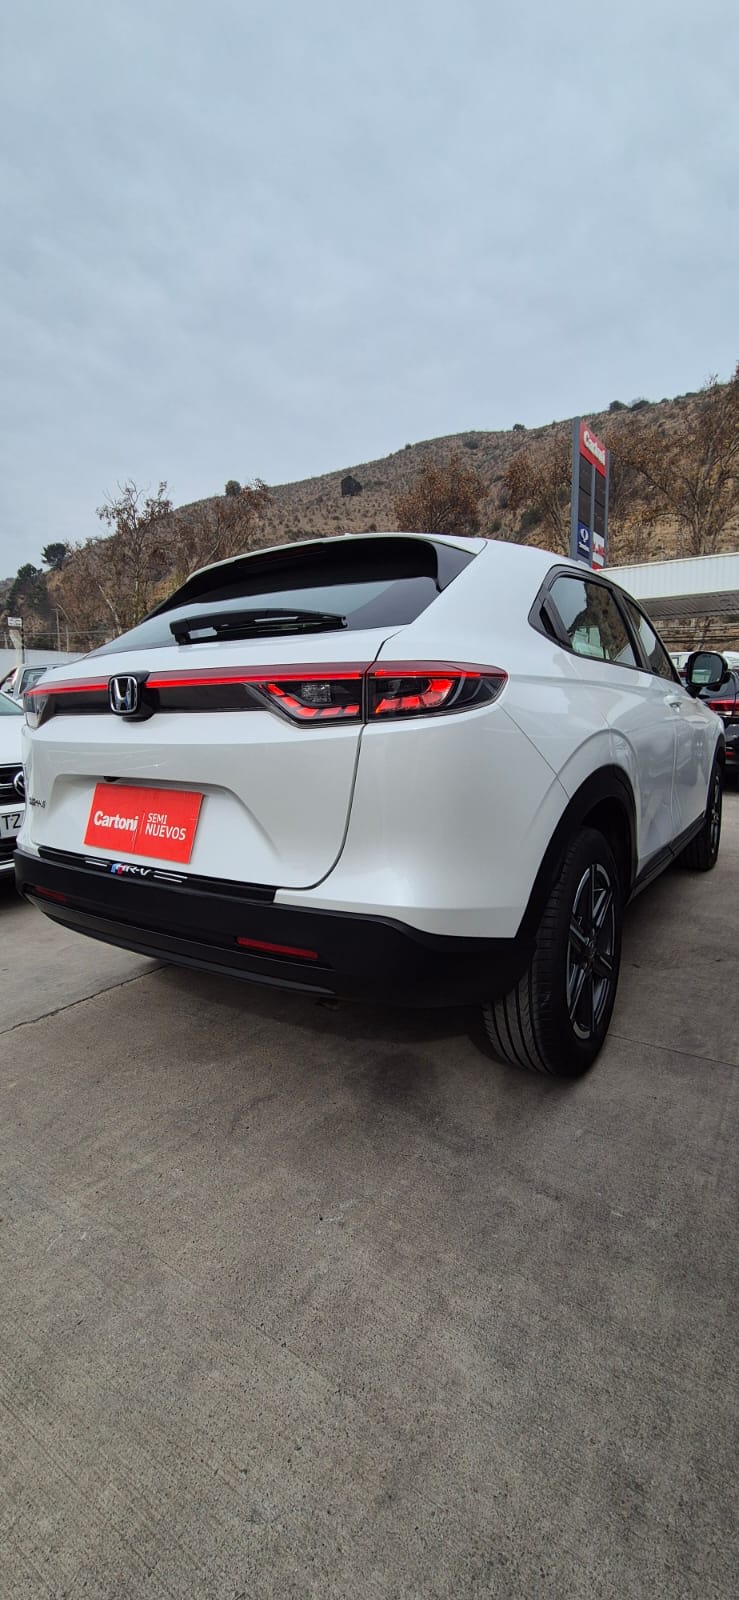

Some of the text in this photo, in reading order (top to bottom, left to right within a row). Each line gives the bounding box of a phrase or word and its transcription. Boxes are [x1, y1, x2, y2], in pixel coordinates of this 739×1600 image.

[94, 810, 139, 832] Cartoni
[147, 812, 168, 825] SEMI
[145, 824, 187, 841] NUEVOS
